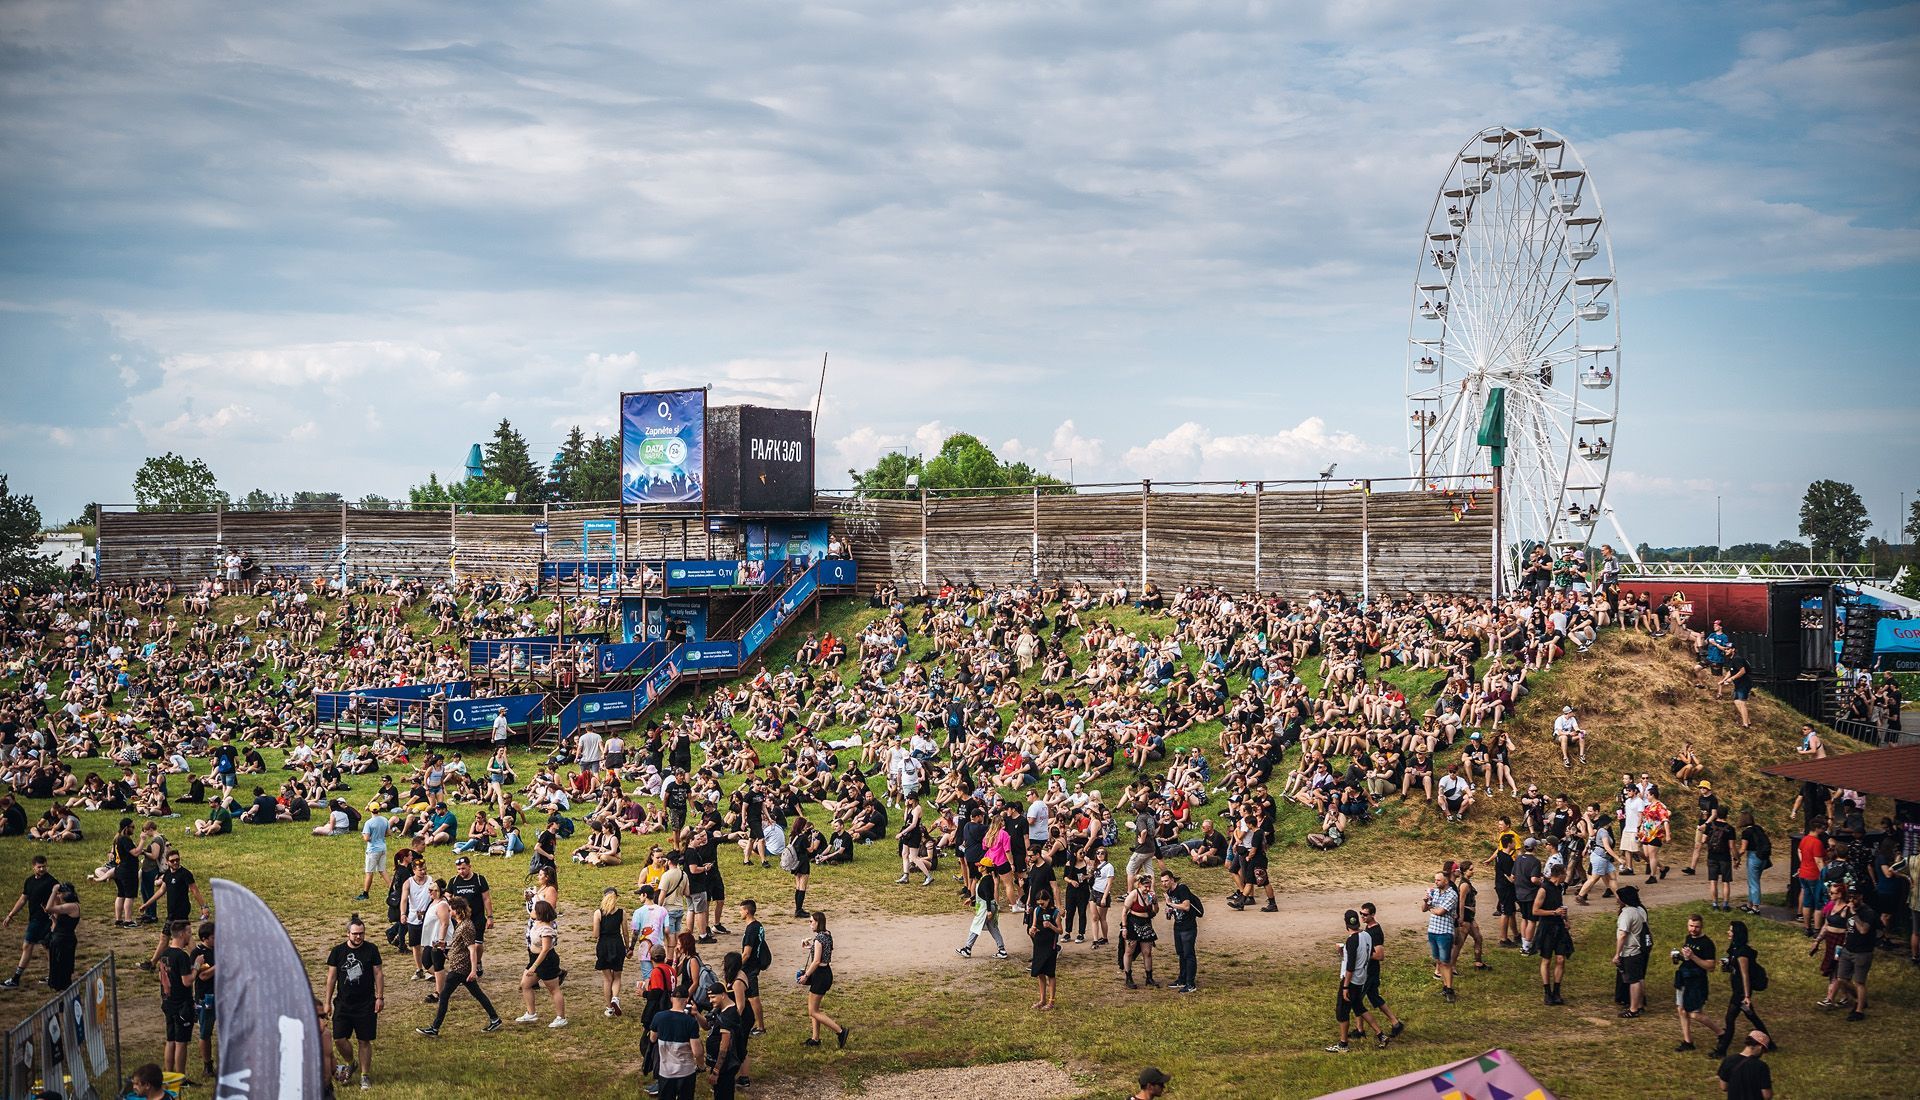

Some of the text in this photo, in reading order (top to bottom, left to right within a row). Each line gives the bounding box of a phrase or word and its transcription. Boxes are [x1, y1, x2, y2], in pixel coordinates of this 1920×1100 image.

[645, 444, 664, 453] DATA
[751, 438, 802, 463] PARK 360
[453, 708, 467, 724] O2
